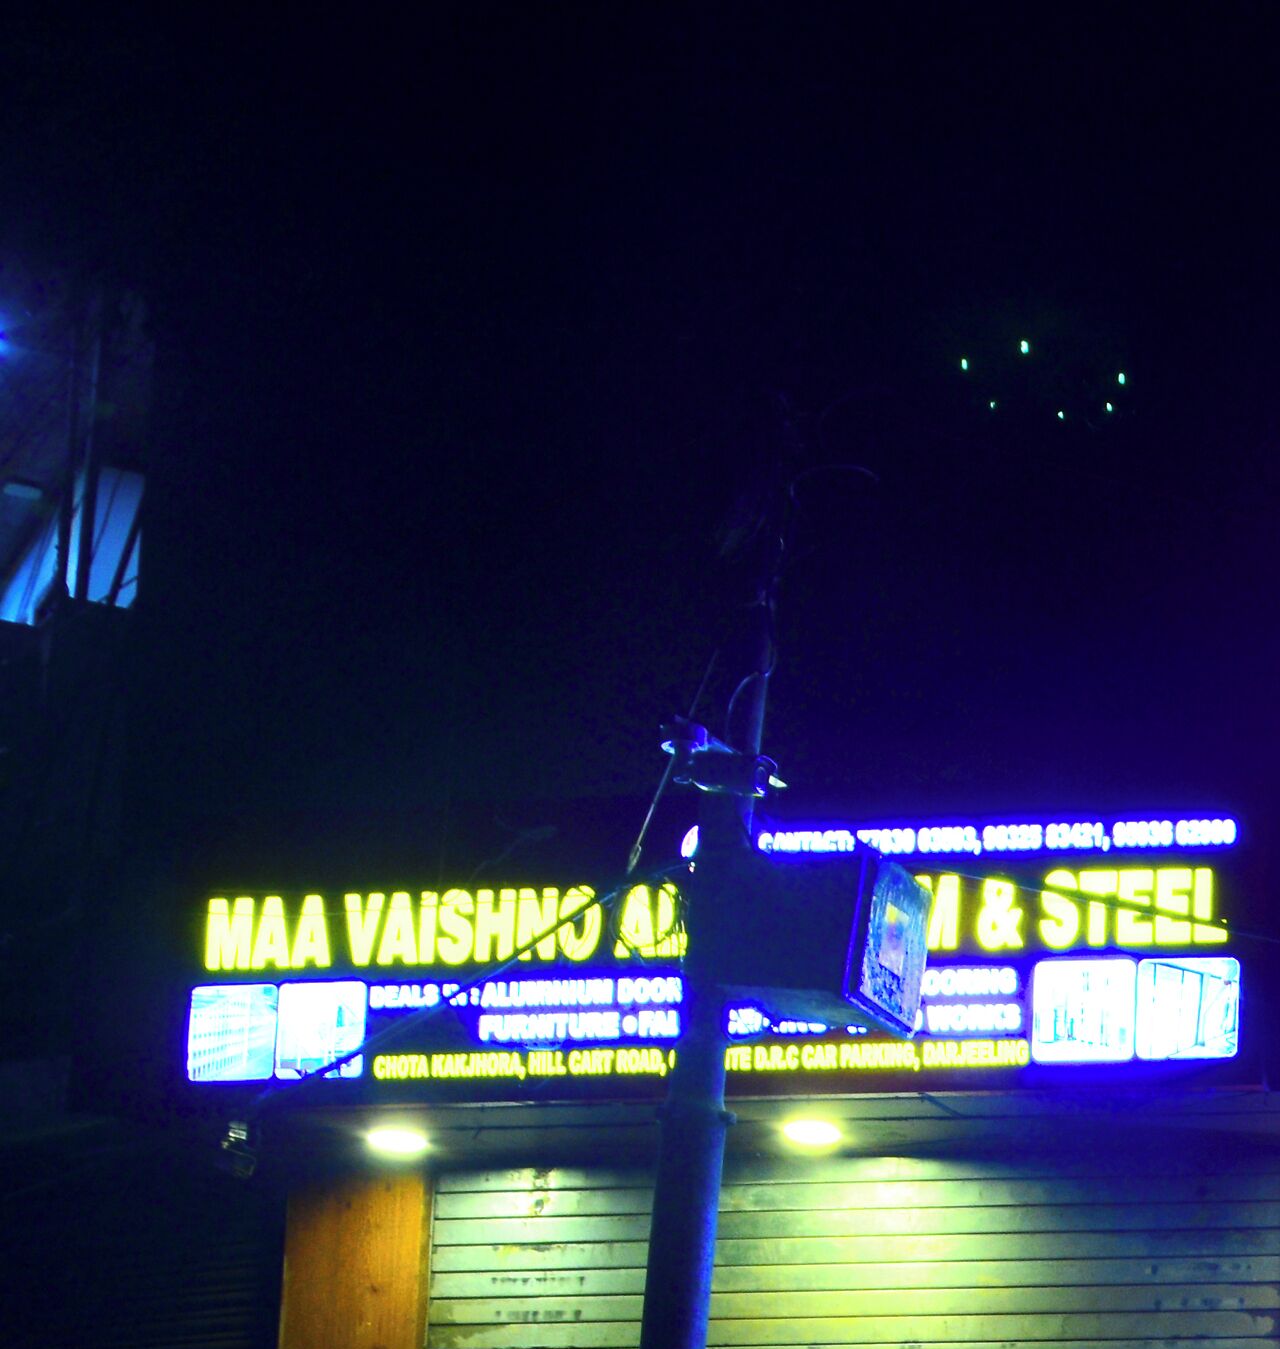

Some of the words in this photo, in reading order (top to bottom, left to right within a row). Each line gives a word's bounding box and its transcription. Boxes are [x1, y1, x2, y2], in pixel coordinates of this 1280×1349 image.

[204, 894, 332, 971] MAA
[344, 884, 602, 967] VAISHNO
[977, 875, 1023, 952] &
[1039, 865, 1229, 950] STEEL
[369, 984, 439, 1008] DEALS
[479, 1012, 620, 1041] FURNITURE
[926, 1004, 1022, 1033] WORKS
[373, 1055, 429, 1079] CHOTA
[527, 1051, 566, 1075] HILL
[567, 1049, 615, 1075] CART
[615, 1048, 667, 1076] ROAD,
[800, 1043, 838, 1070] CAR
[839, 1041, 920, 1072] PARKING,
[922, 1039, 1029, 1068] DARJEELING
